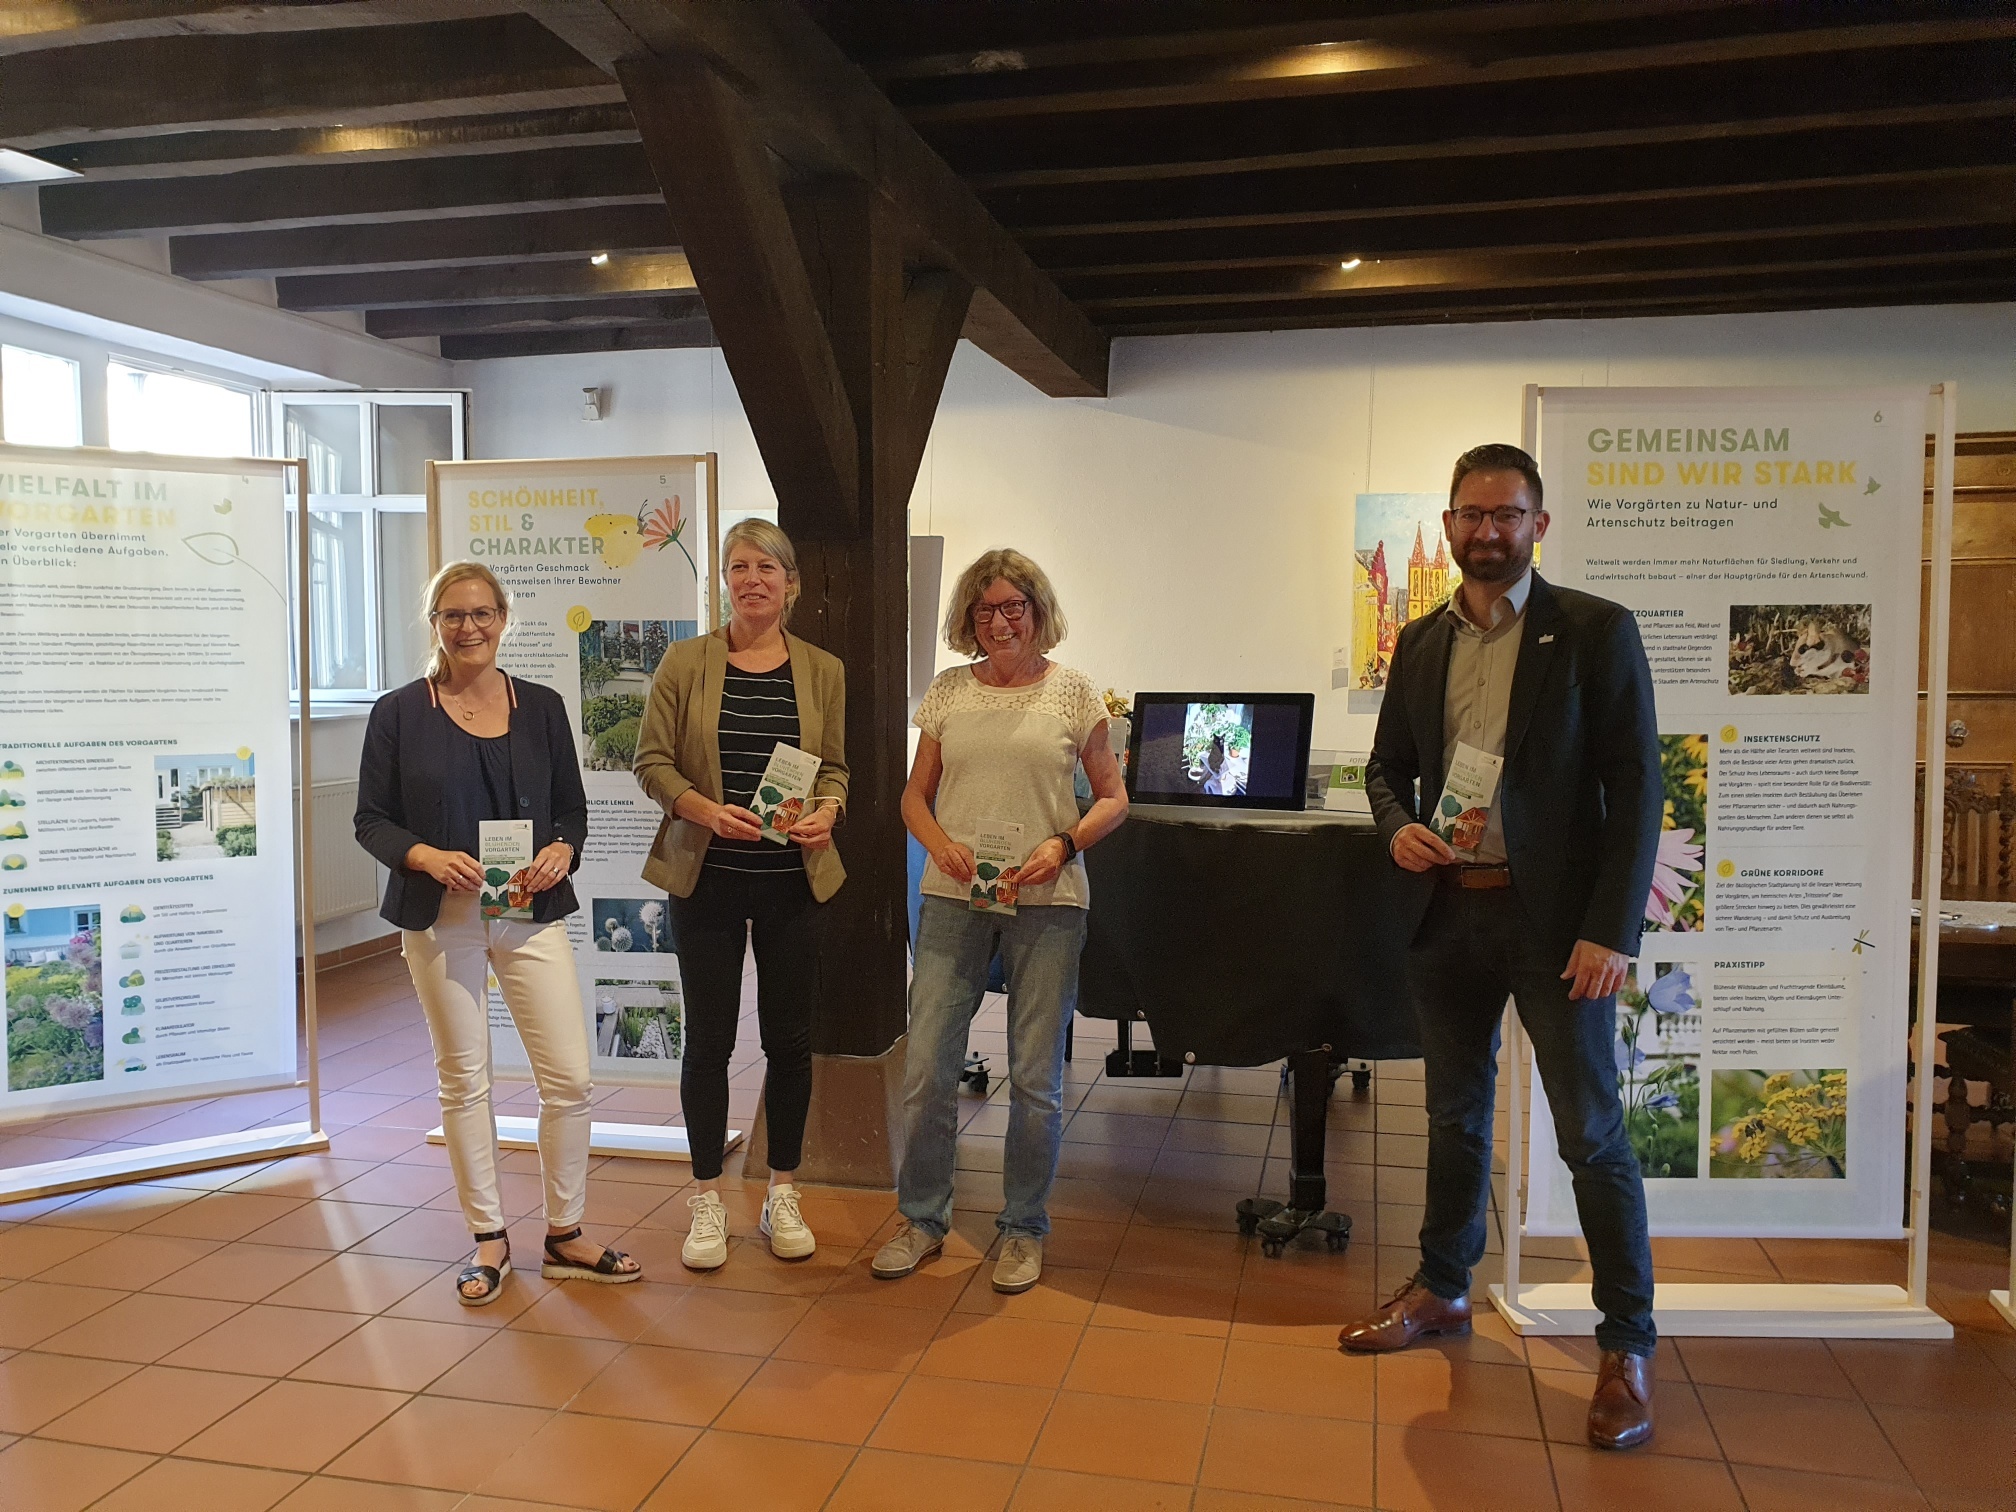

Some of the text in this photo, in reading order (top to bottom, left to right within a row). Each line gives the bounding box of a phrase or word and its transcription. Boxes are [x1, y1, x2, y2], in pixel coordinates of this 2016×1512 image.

[1874, 411, 1883, 423] 6
[1588, 429, 1789, 452] GEMEINSAM
[659, 475, 667, 485] 5
[1587, 460, 1856, 486] SIND WIR STARK
[0, 473, 168, 501] IELFALT IM
[468, 486, 605, 509] SCHÖNHEIT,
[1587, 499, 1611, 509] Wie
[1616, 499, 1681, 512] Vorgärten
[1706, 499, 1747, 509] Natur-
[1753, 498, 1778, 509] und
[0, 501, 177, 527] ORGARTEN
[470, 513, 534, 532] STIL &
[1587, 517, 1734, 529] Artenschutz beitragen
[14, 528, 77, 540] Vorgarten
[81, 531, 146, 542] übernimmt
[22, 544, 103, 554] verschiedene
[107, 546, 169, 558] Aufgaben.
[470, 536, 605, 555] CHARAKTER
[13, 554, 77, 567] Überblick:
[1771, 558, 1808, 566] Siedlung,
[489, 564, 590, 575] Vorgärten Geschmack
[1724, 573, 1776, 581] Hauptgründe
[1741, 869, 1771, 877] GRÜNE
[3, 885, 54, 894] ZUNEHMEND
[57, 882, 101, 890] RELEVANTE
[103, 879, 145, 887] AUFGABEN
[163, 875, 214, 883] VORGARTENS
